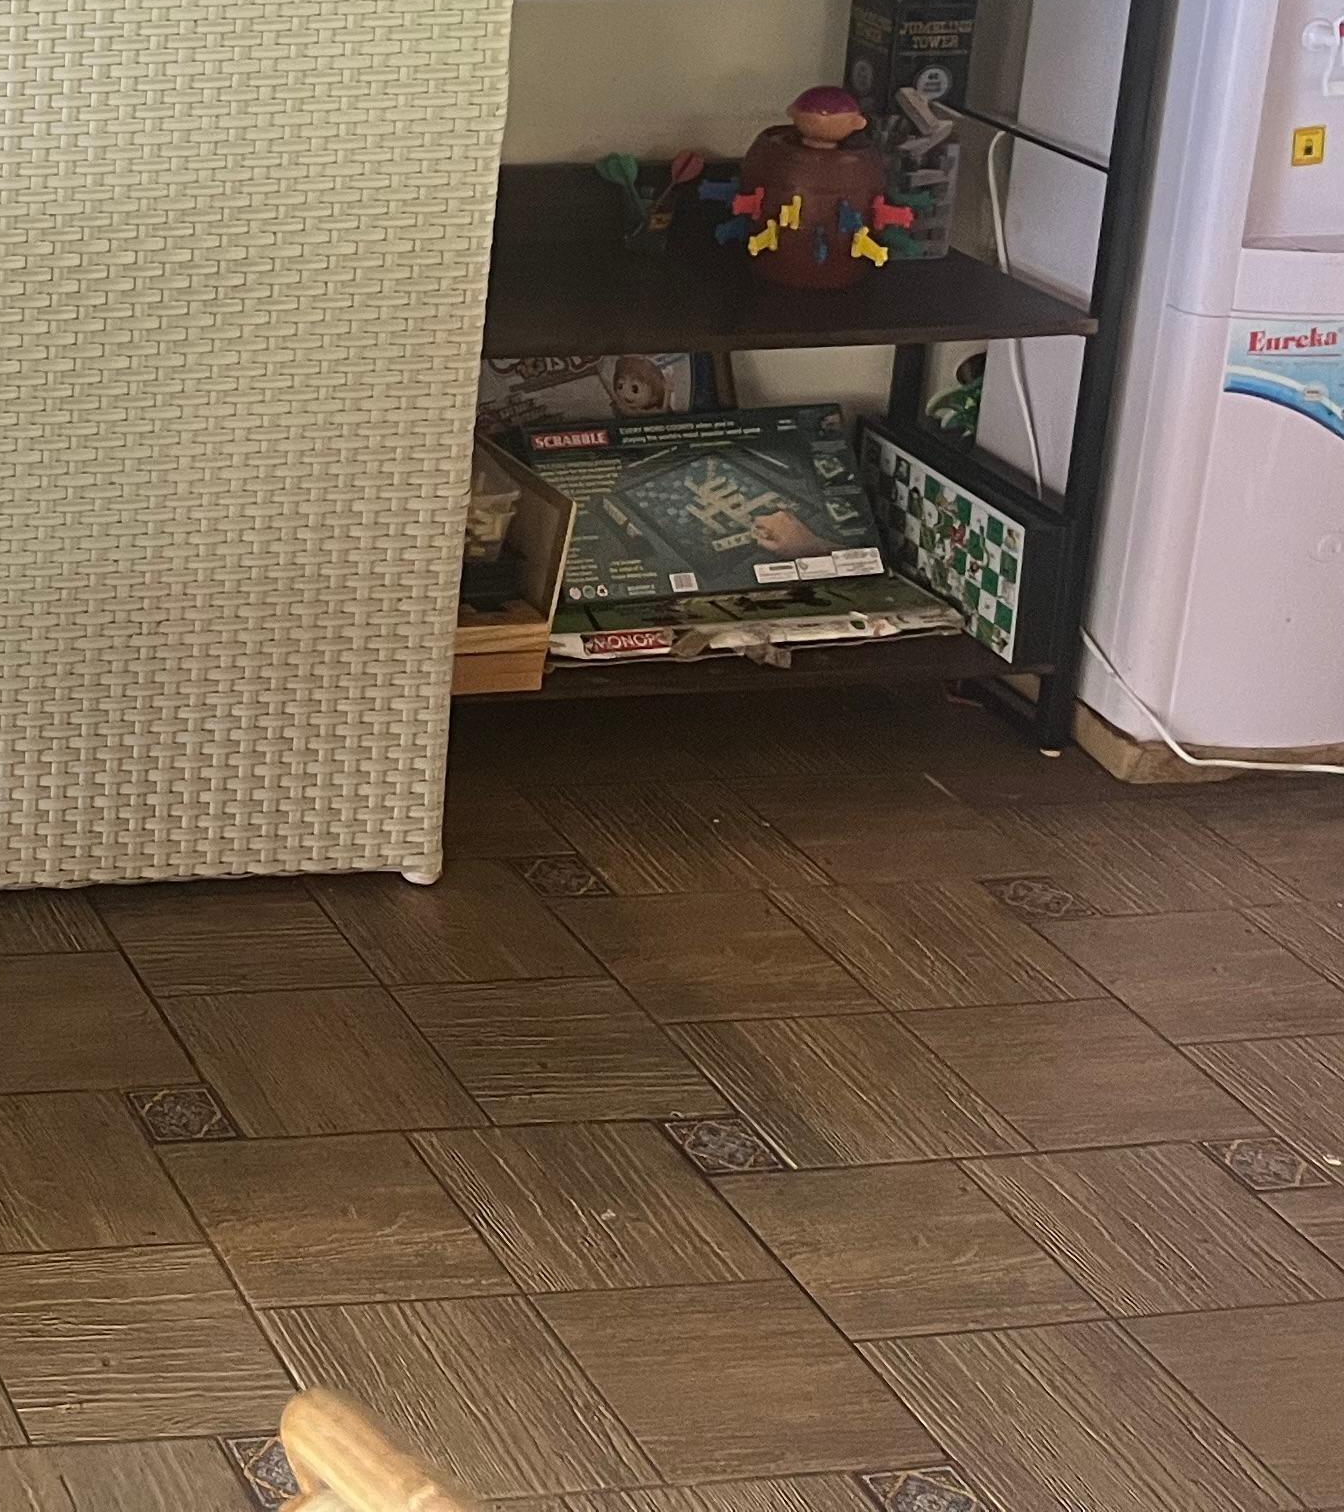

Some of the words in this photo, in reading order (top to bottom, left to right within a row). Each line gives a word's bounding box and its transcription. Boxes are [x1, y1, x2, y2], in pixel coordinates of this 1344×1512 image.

[912, 34, 960, 49] TOWER
[1247, 327, 1338, 352] Eureka
[535, 431, 608, 448] SCRABBLE
